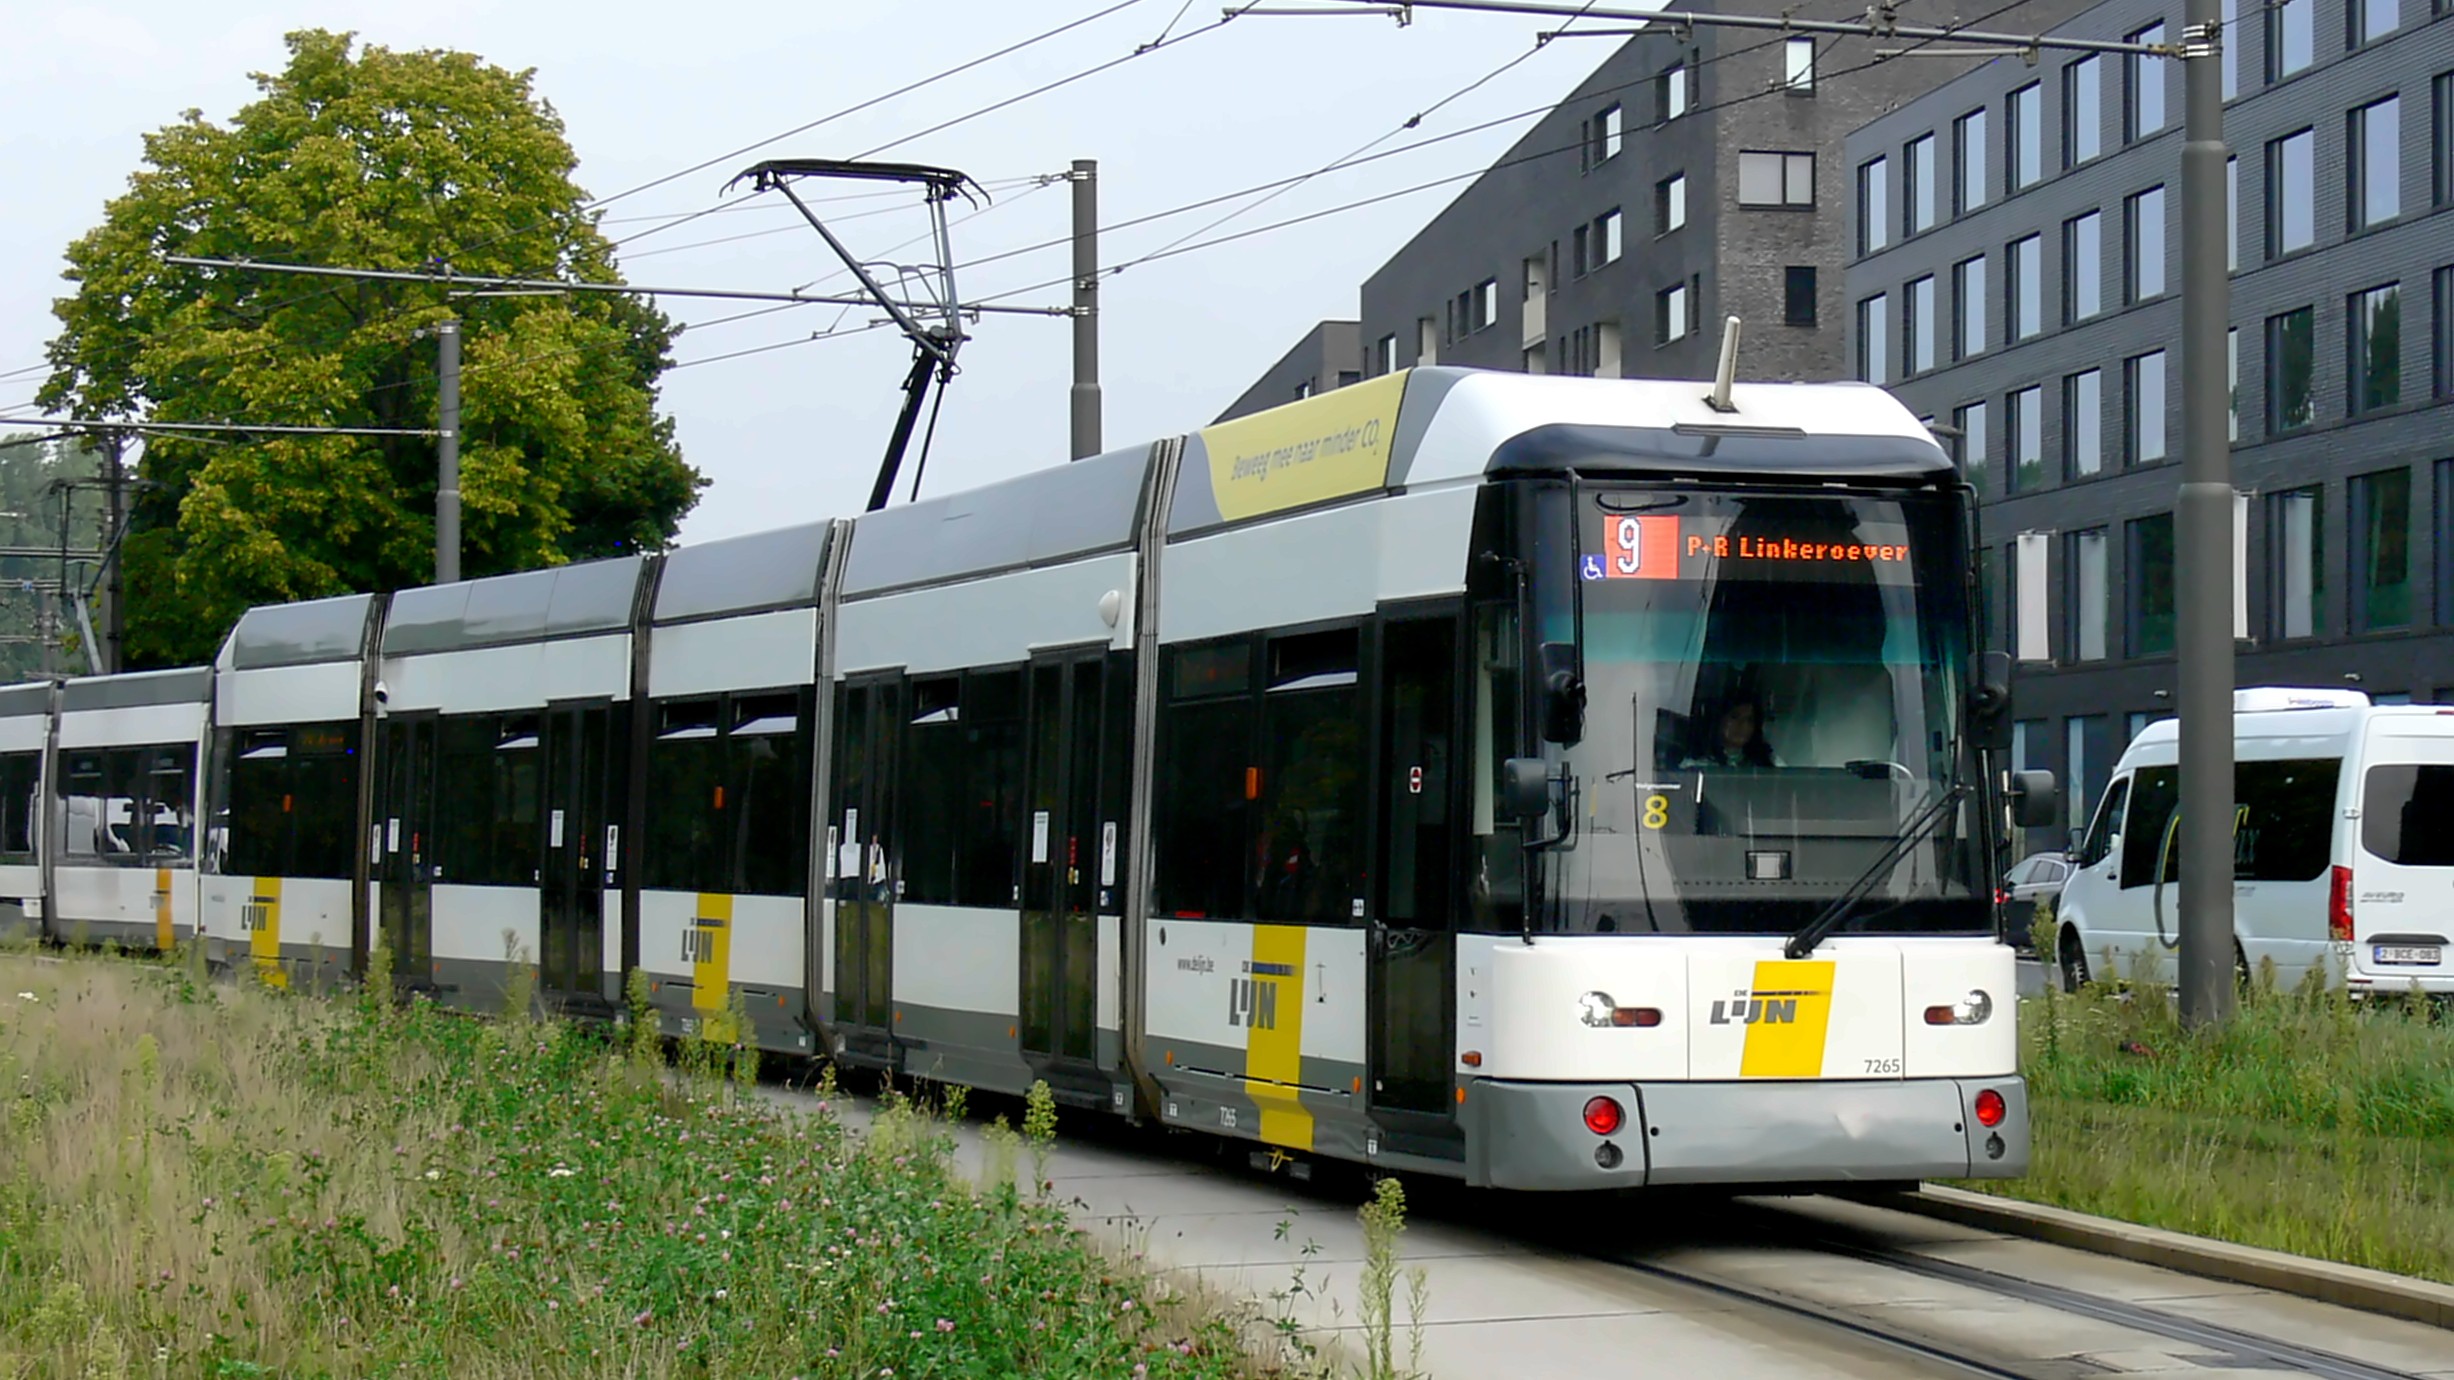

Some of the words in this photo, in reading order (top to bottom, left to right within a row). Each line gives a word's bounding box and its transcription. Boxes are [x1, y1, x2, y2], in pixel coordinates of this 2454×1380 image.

[1270, 446, 1294, 468] mee
[1294, 439, 1321, 464] naar
[1617, 516, 1641, 575] 9
[1687, 536, 1729, 557] P+R
[1739, 537, 1908, 561] Linkeroever
[1642, 794, 1669, 829] 8
[1229, 978, 1277, 1030] LIJN
[1733, 989, 1748, 997] DE
[1710, 1000, 1797, 1024] LIJN
[1864, 1058, 1900, 1073] 7265
